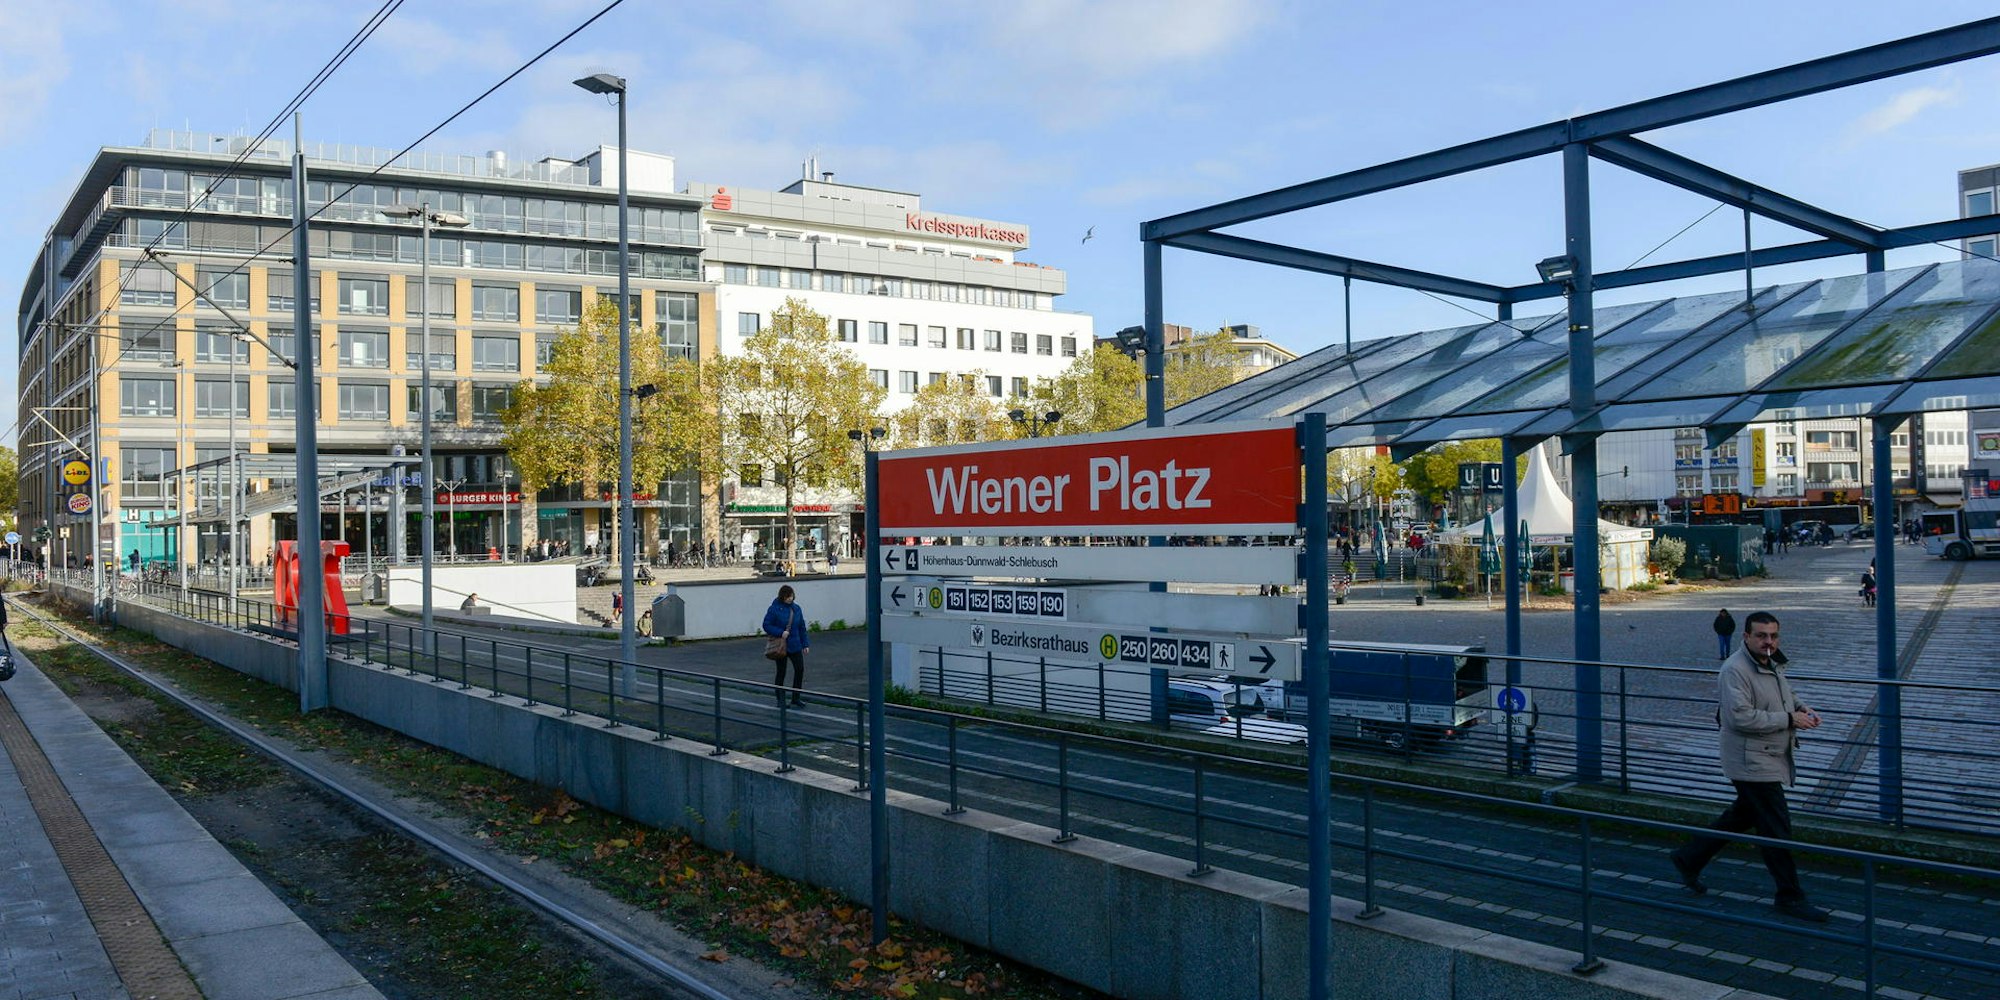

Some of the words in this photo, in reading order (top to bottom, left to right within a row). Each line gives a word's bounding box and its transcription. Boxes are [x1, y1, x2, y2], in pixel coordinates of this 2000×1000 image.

[906, 213, 1025, 244] Kreissparkasse
[1464, 469, 1474, 484] U
[1491, 468, 1500, 484] U
[926, 465, 1070, 515] Wiener
[1089, 455, 1212, 511] Platz
[71, 501, 90, 509] KING
[450, 494, 487, 503] BURGER
[489, 493, 512, 502] KING
[129, 509, 139, 520] H
[60, 528, 70, 538] H
[907, 552, 917, 567] 4
[923, 555, 1058, 568] Höhenhaus-Dünnwald-Schlebusch
[949, 592, 964, 607] 151
[970, 593, 988, 608] 152
[992, 594, 1012, 610] 153
[1017, 595, 1036, 612] 159
[1042, 596, 1064, 613] 190
[991, 629, 1089, 654] Bezirksrathaus
[1122, 641, 1146, 658] 250
[1151, 643, 1177, 661] 260
[1182, 645, 1209, 664] 434
